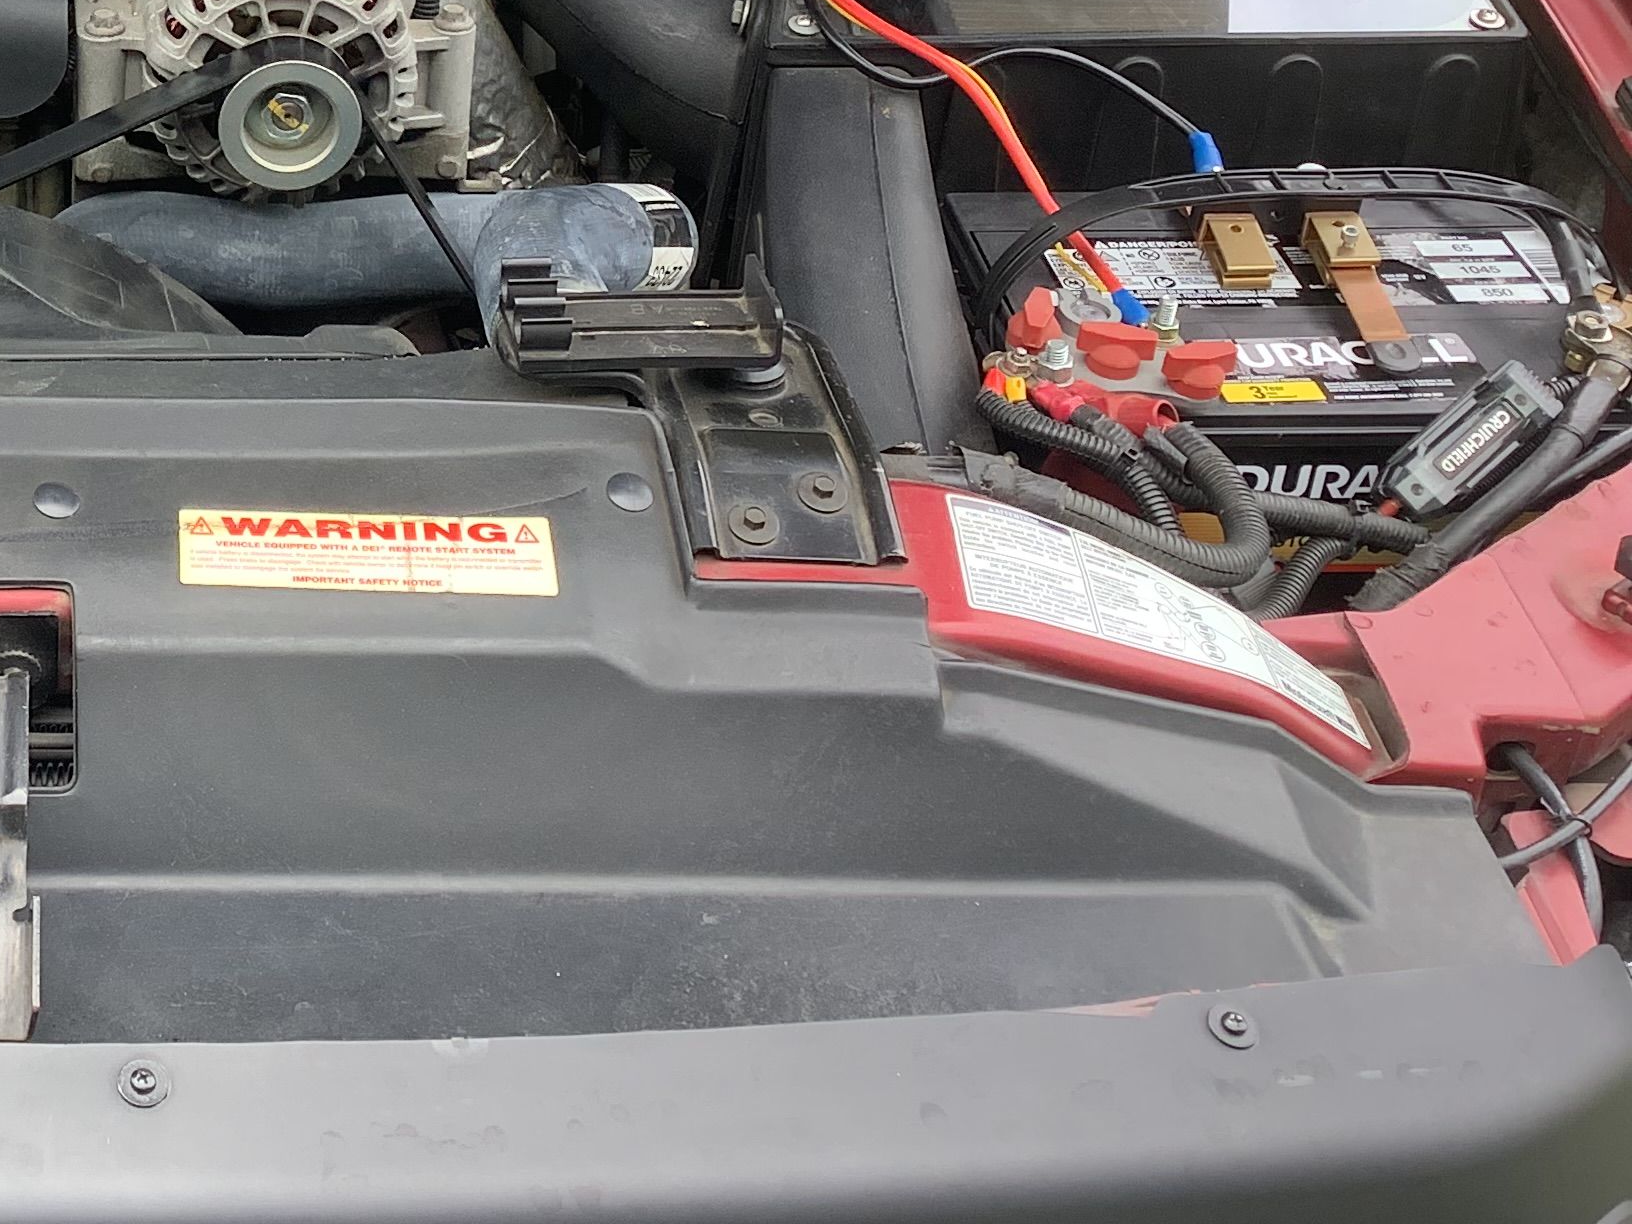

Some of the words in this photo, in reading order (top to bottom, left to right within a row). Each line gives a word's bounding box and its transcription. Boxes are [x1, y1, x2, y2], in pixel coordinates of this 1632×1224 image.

[1451, 243, 1473, 253] 65
[1459, 264, 1501, 275] 1045
[1481, 287, 1514, 297] 850
[1249, 385, 1266, 399] 3
[1441, 410, 1511, 473] CRUTCHFIELD
[1239, 464, 1380, 500] DURA
[221, 517, 508, 543] WARNING
[215, 540, 261, 549] VEHICLE
[263, 542, 318, 551] EQUIPPED
[388, 545, 433, 553] REMOTE
[435, 546, 470, 554] START
[292, 575, 355, 585] IMPORTANT
[358, 577, 399, 586] SAFETY
[402, 579, 443, 587] NOTICE
